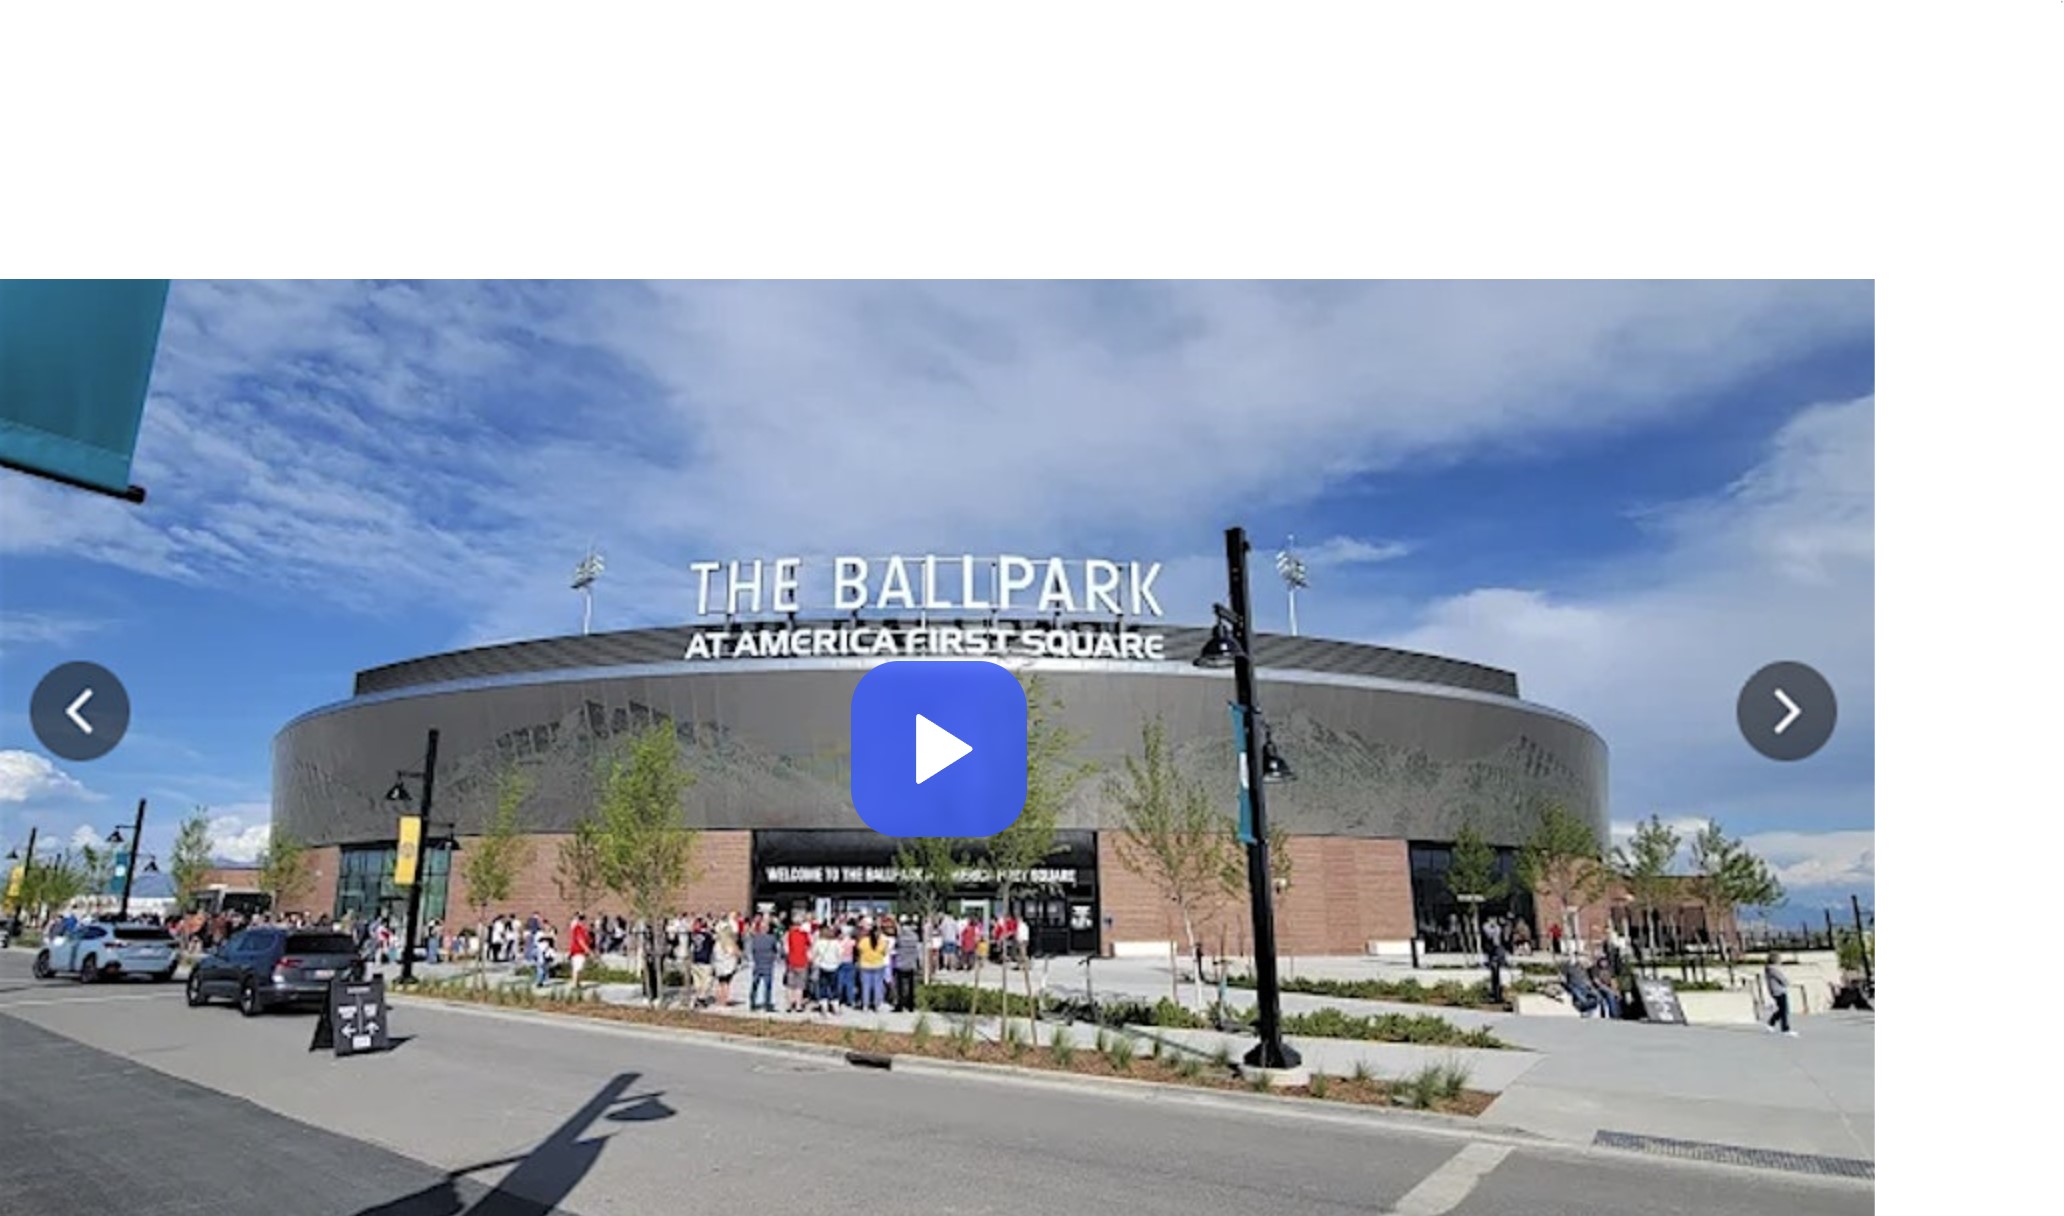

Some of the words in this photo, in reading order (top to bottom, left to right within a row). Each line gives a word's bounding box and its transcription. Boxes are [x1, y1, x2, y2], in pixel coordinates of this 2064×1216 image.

[690, 557, 800, 615] THE
[834, 554, 1163, 617] BALLPARK
[685, 631, 730, 660] AT
[733, 627, 898, 657] AMERICA
[905, 627, 1016, 656] FIRST
[1021, 628, 1165, 660] SQUARE
[765, 866, 823, 883] WELCOME
[824, 866, 840, 883] TO
[841, 866, 864, 883] THE
[1030, 868, 1077, 883] SQUARE
